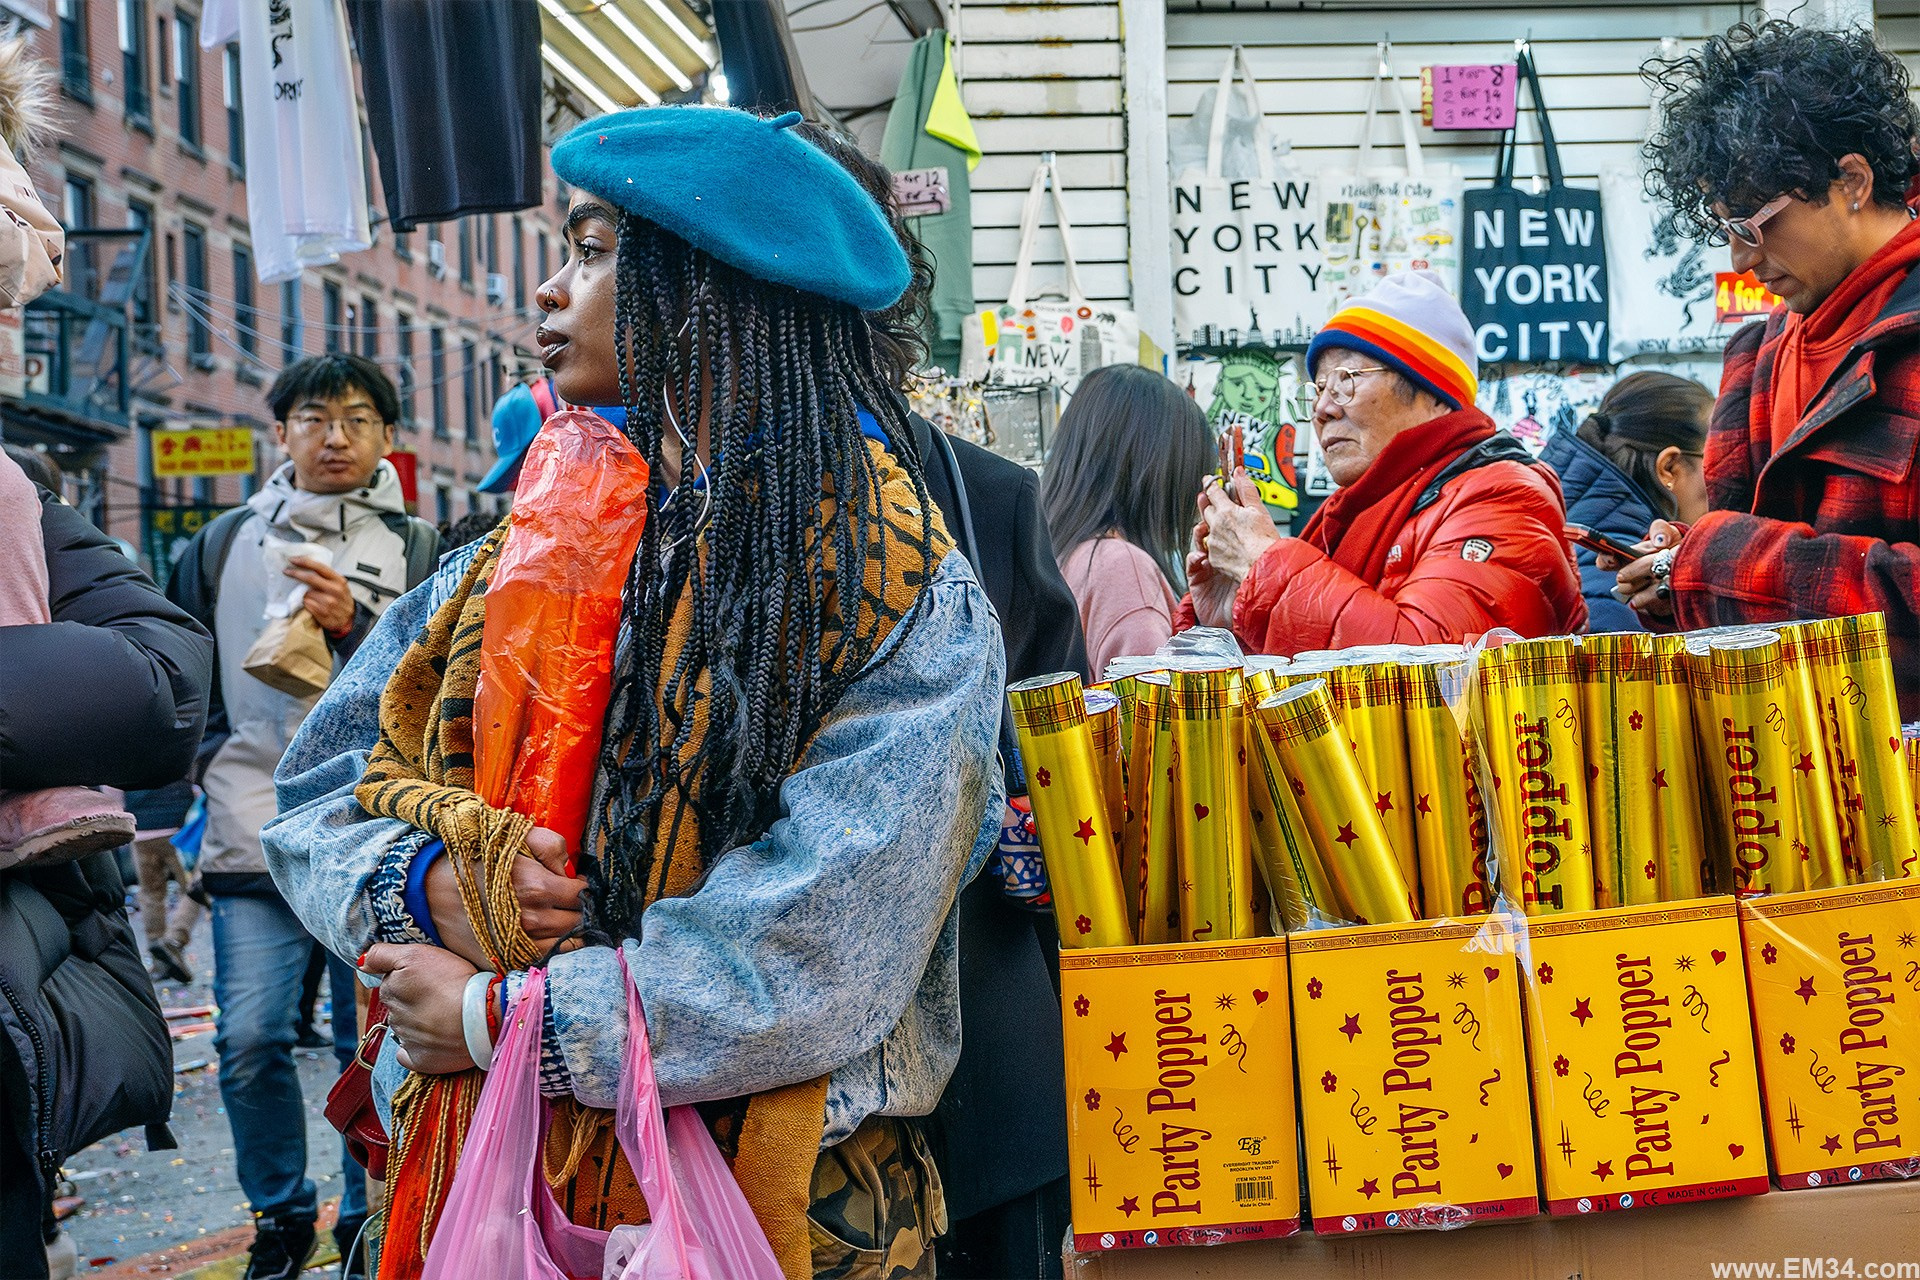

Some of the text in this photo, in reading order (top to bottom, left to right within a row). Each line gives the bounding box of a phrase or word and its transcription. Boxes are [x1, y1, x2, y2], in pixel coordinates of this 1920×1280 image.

[1443, 66, 1451, 83] 1
[1490, 65, 1503, 86] 8
[1442, 90, 1455, 104] 2
[1485, 88, 1501, 103] 14
[1444, 109, 1454, 125] 3
[1483, 106, 1502, 124] 20
[1175, 181, 1309, 214] NEW
[1174, 223, 1319, 254] YORK
[1473, 207, 1595, 249] NEW
[1175, 264, 1321, 296] CITY
[1473, 263, 1603, 305] YORK
[1716, 281, 1731, 313] 4
[1734, 280, 1766, 312] for
[1026, 345, 1069, 368] NEW
[1475, 320, 1606, 362] CITY
[1221, 412, 1269, 434] NEW
[1513, 711, 1573, 910] Popper
[1838, 932, 1895, 1054] Popper
[1614, 953, 1680, 1180] Party Popper
[1382, 969, 1449, 1199] Party Popper
[1147, 989, 1212, 1217] Party Popper
[1846, 1062, 1905, 1154] Party
[1667, 1189, 1694, 1200] MADE
[1696, 1188, 1706, 1196] IN
[1708, 1184, 1737, 1195] CHINA
[1476, 1204, 1505, 1215] CHINA
[1235, 1225, 1265, 1235] CHINA
